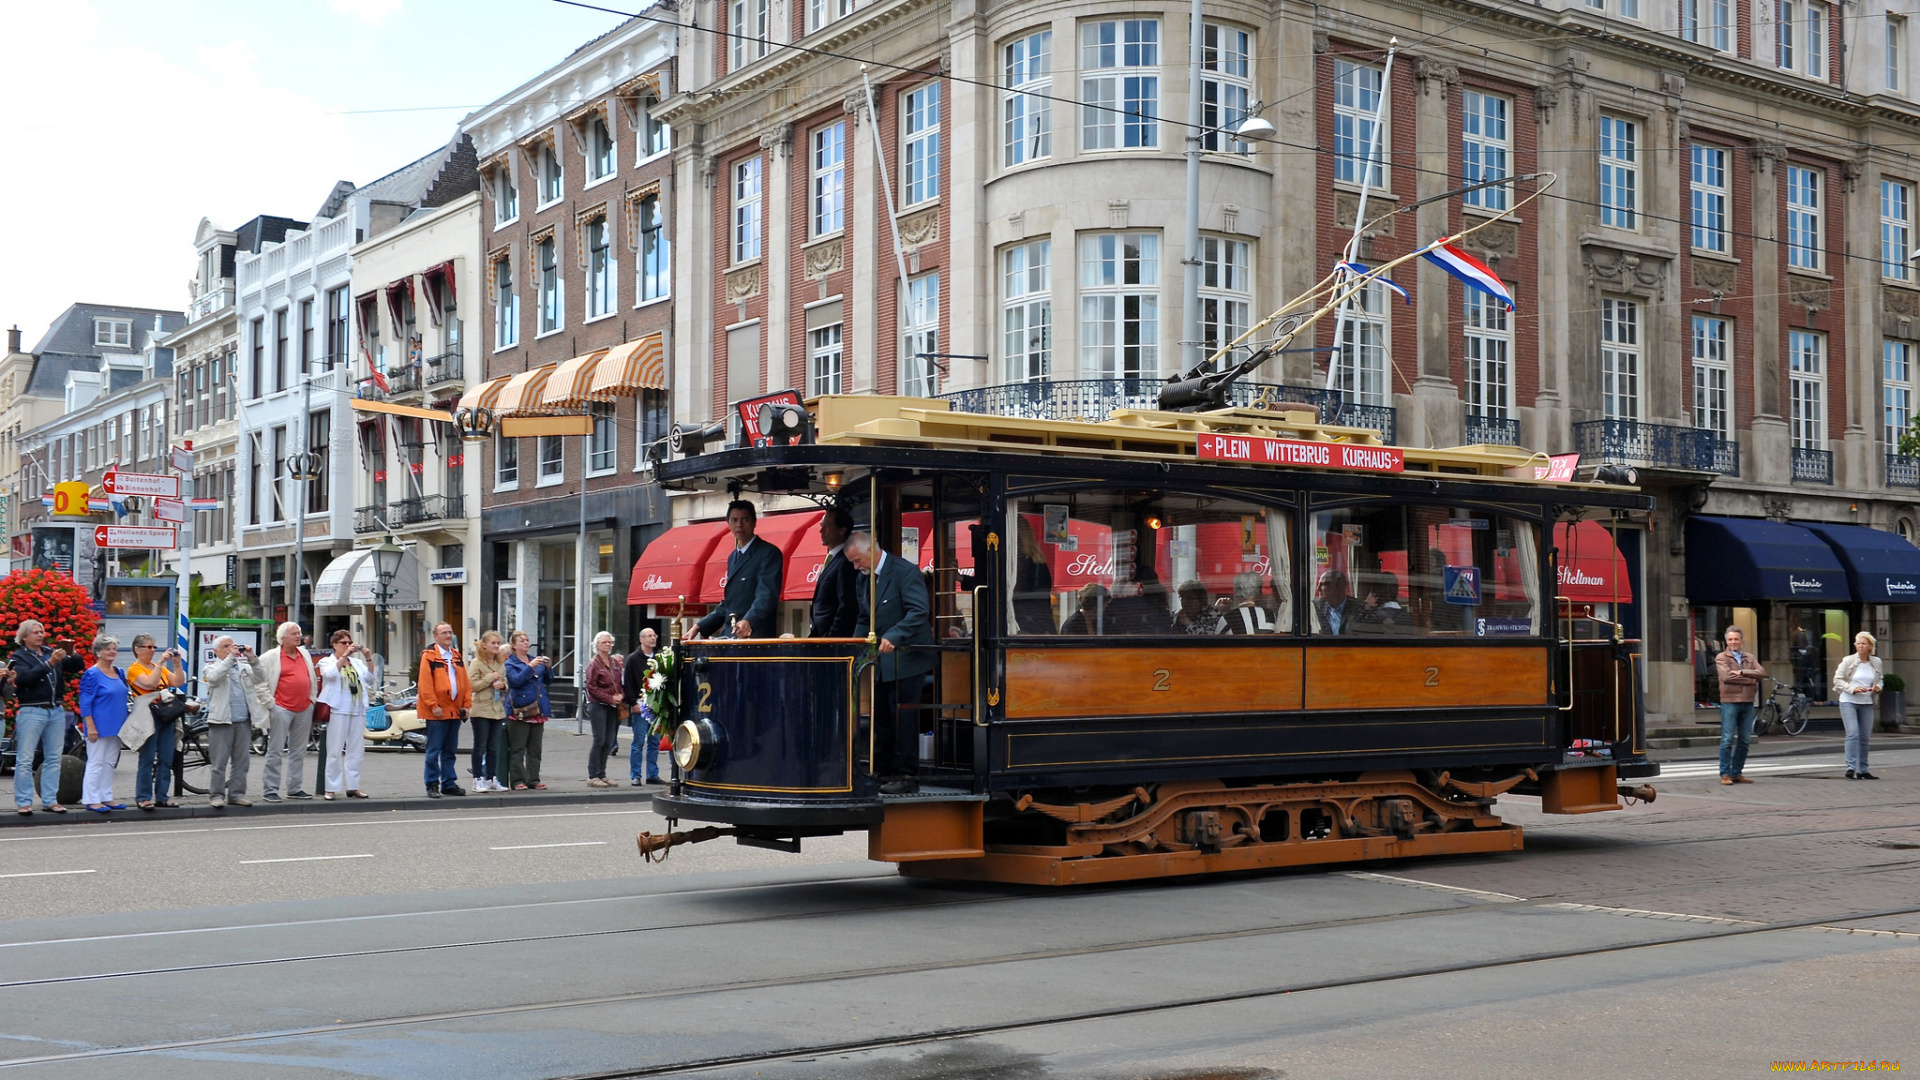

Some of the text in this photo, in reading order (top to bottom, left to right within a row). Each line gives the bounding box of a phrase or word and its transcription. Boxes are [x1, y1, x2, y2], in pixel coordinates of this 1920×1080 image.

[1215, 437, 1392, 469] PLEIN WITTEBRUG KURHAUS
[125, 476, 160, 484] Buitenhof
[643, 574, 673, 591] Steltman
[1557, 565, 1604, 586] Steltman
[1152, 669, 1171, 691] 2
[1424, 666, 1440, 687] 2
[697, 682, 712, 712] 2
